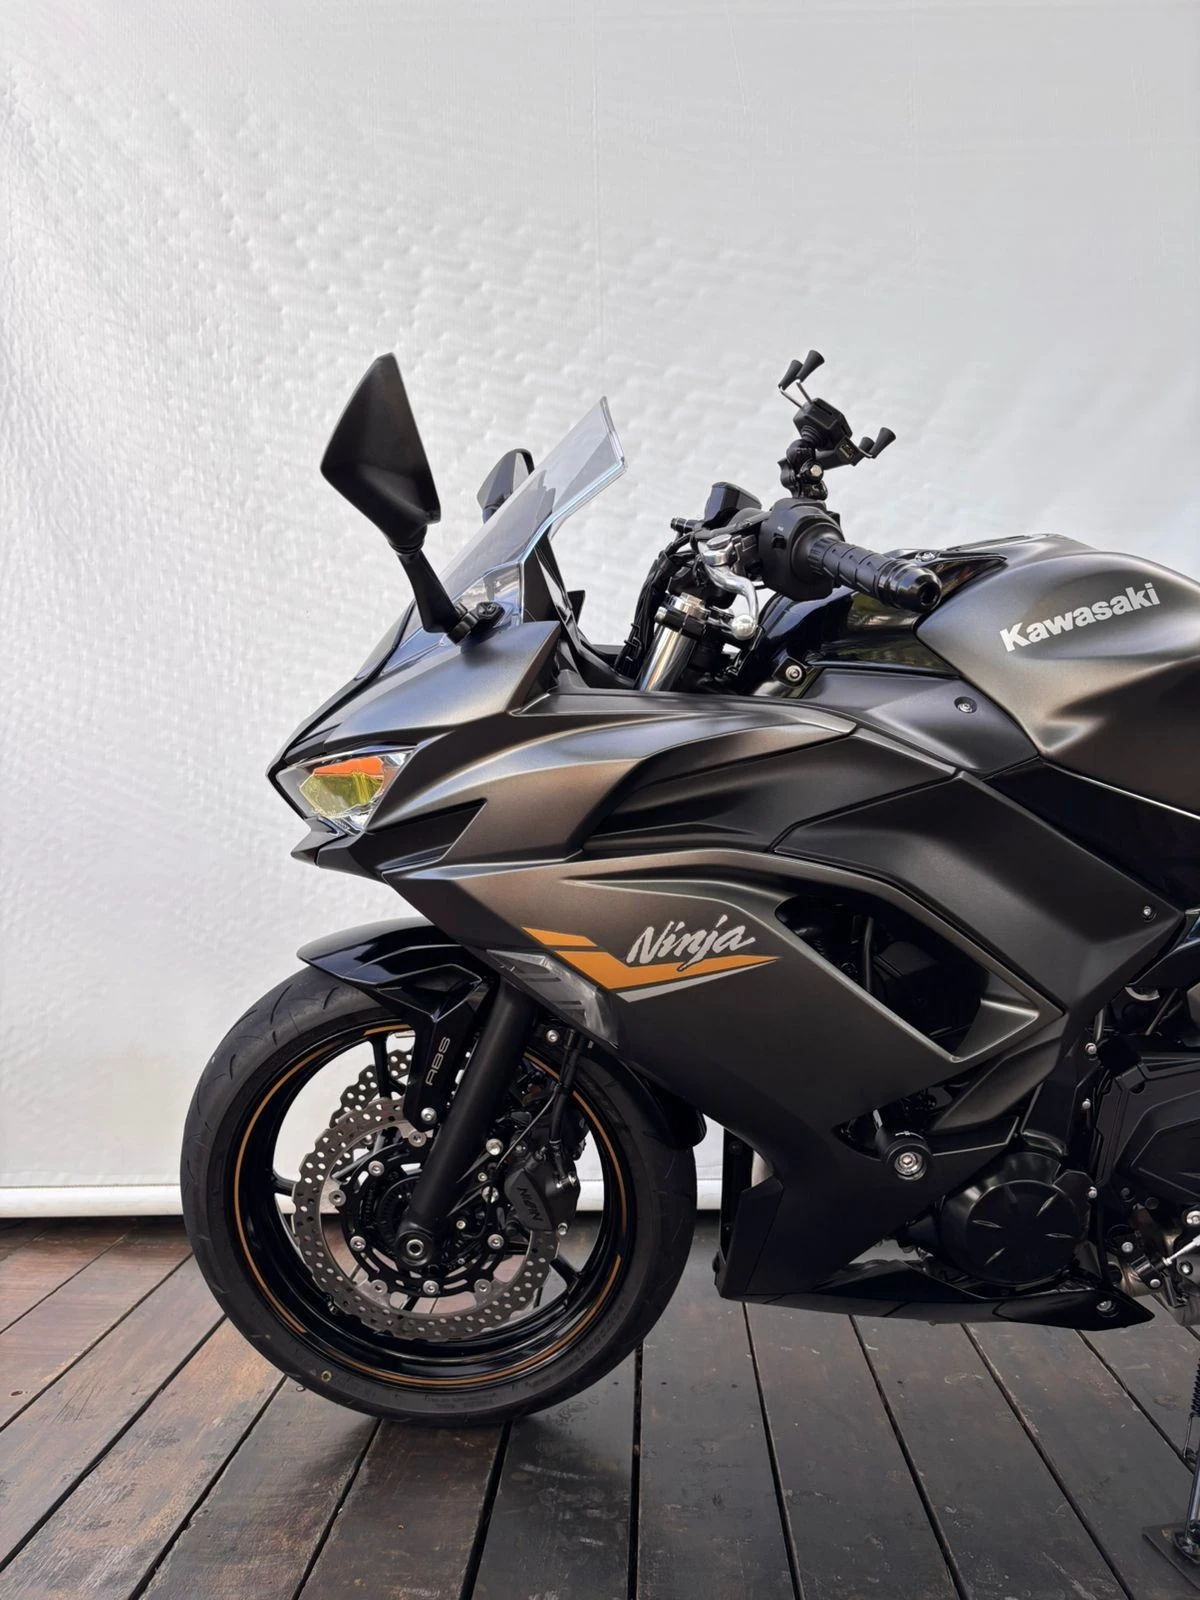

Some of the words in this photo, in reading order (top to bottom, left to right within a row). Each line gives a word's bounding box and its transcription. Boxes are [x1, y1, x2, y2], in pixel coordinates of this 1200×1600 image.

[1000, 583, 1160, 652] Kawasaki
[626, 915, 755, 971] Ninja
[425, 1037, 450, 1085] ABS
